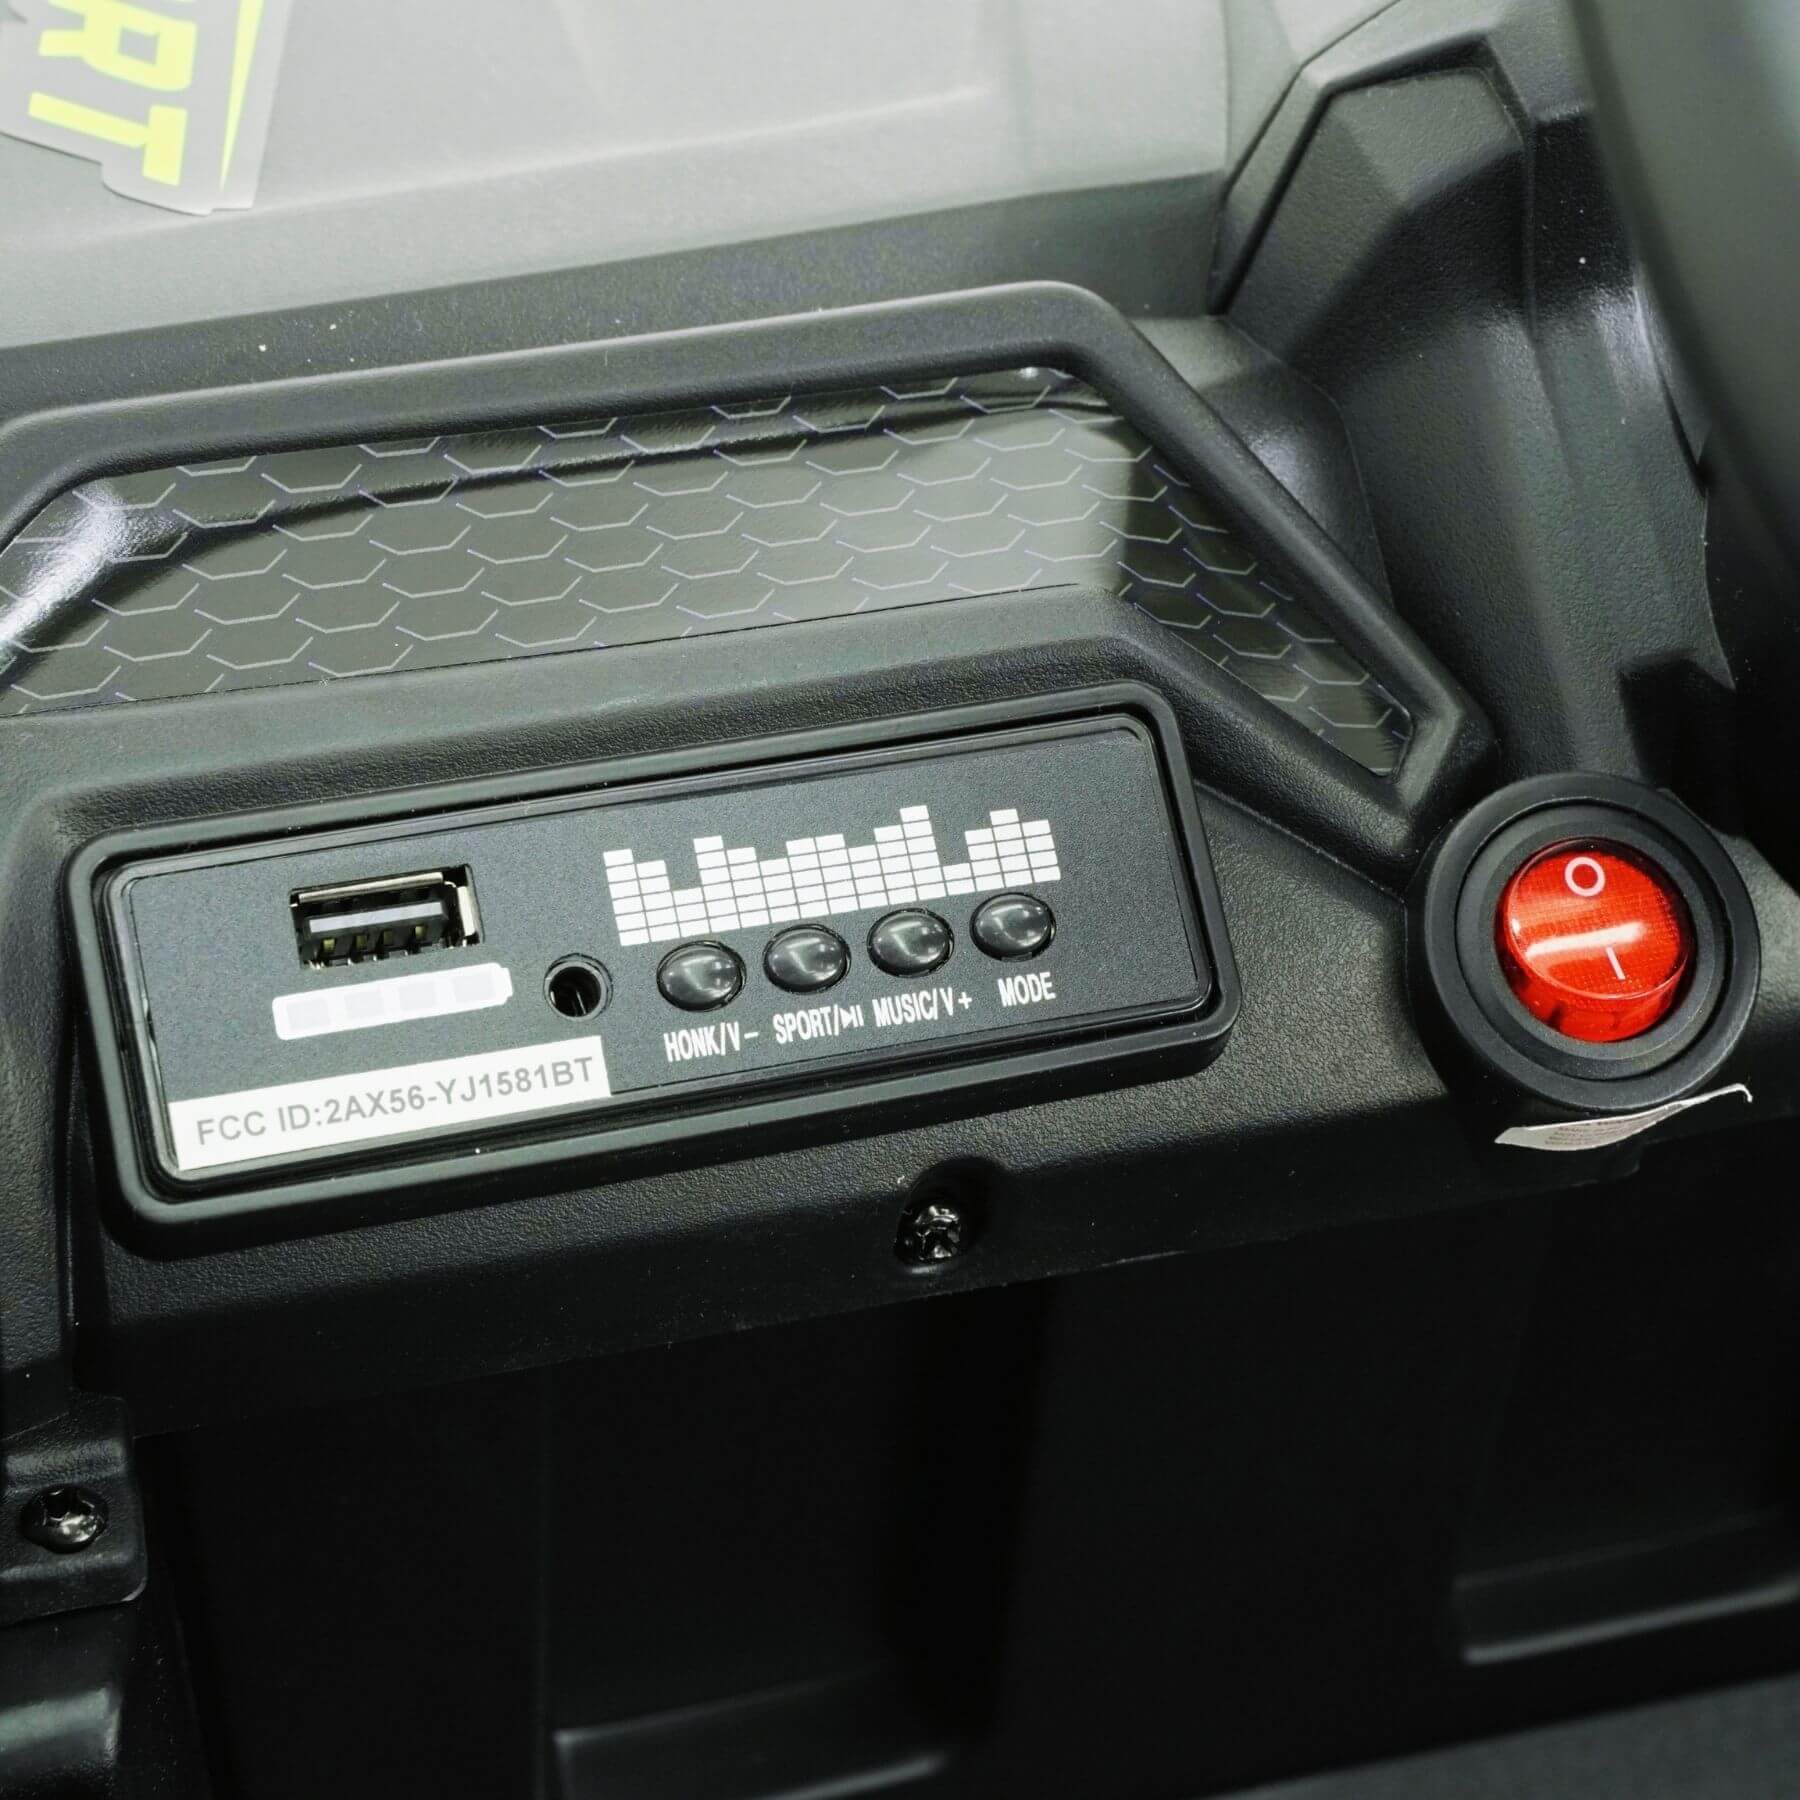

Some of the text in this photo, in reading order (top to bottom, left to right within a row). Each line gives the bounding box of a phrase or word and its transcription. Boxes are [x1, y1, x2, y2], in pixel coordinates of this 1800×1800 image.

[997, 971, 1056, 1007] MODE
[196, 1056, 593, 1145] FCC ID:2AX56-YJ1581BT
